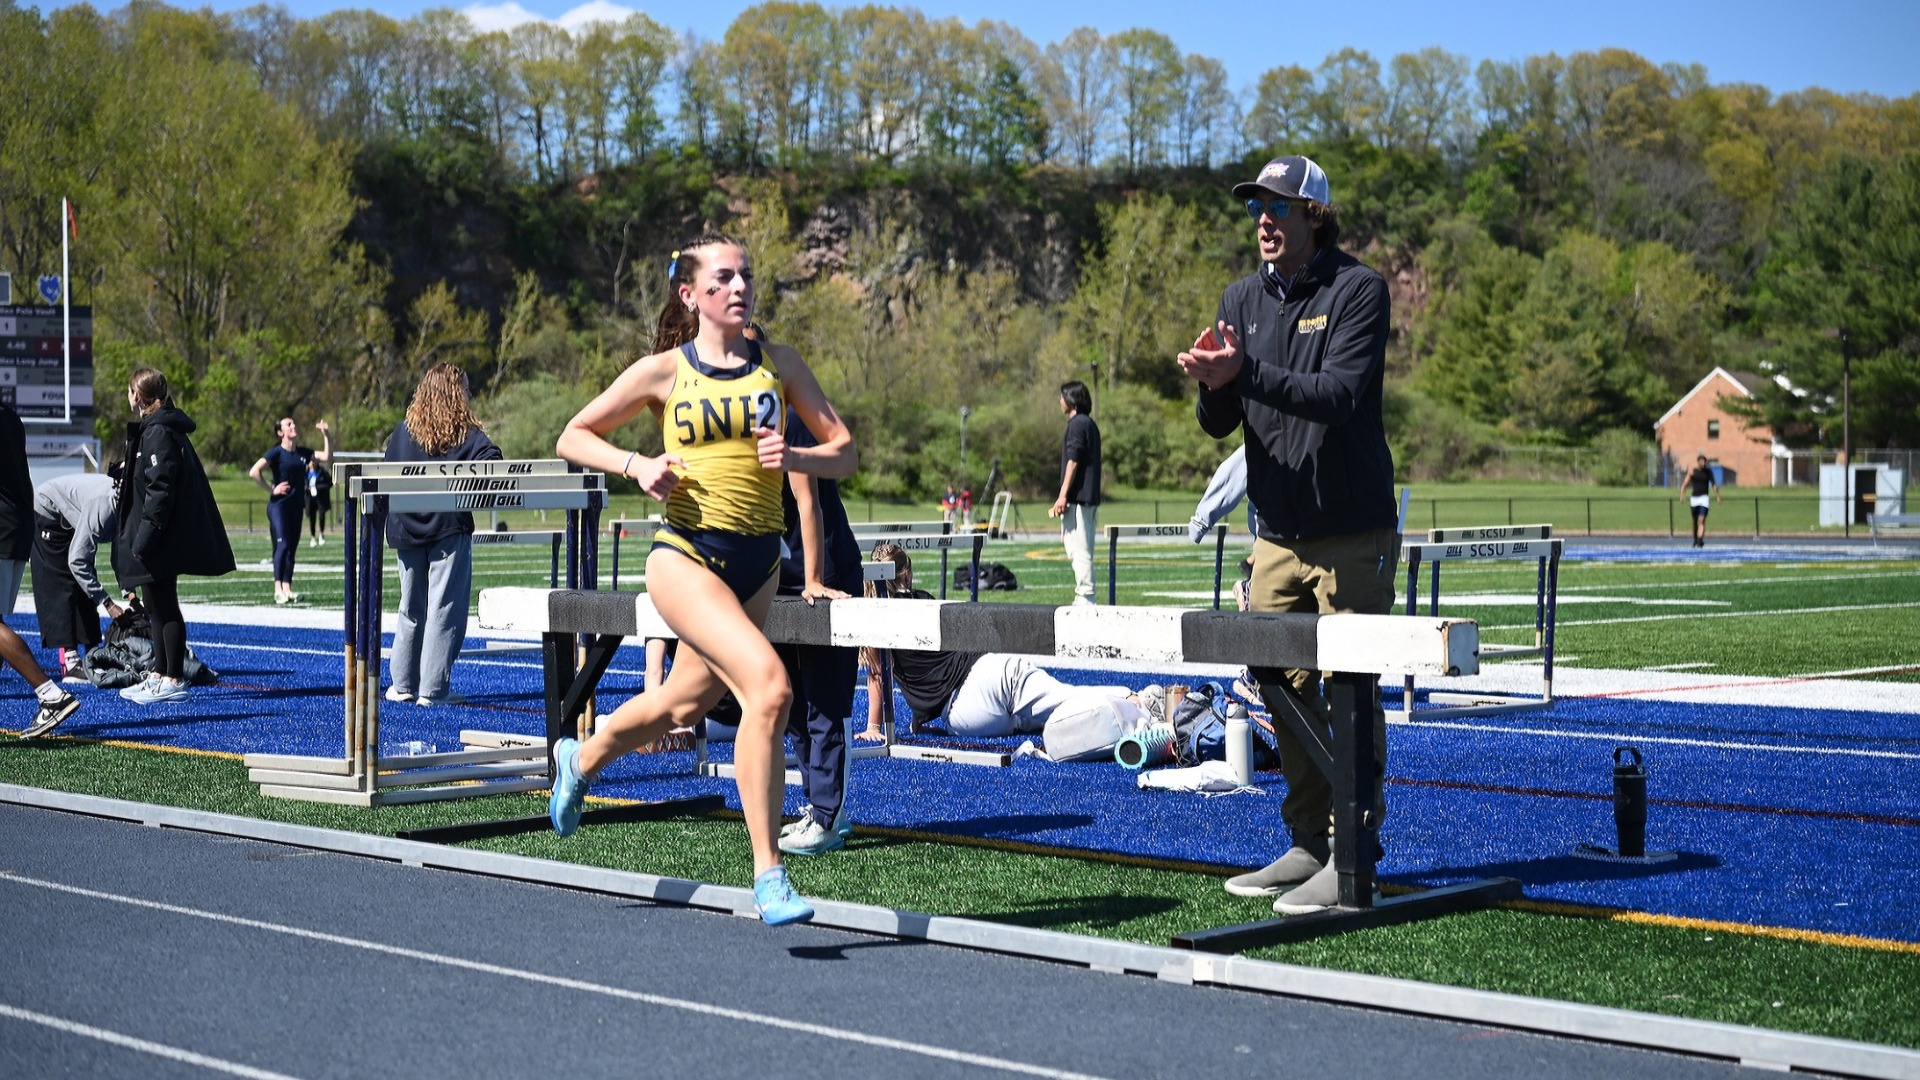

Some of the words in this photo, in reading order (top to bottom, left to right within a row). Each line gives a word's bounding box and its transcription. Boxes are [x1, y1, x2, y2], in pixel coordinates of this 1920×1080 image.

[758, 393, 776, 431] 2
[401, 465, 427, 476] GILL
[508, 463, 533, 474] GILL
[489, 480, 517, 491] GILL
[496, 495, 523, 506] GILL
[1155, 526, 1183, 536] SCSU
[1479, 528, 1507, 539] SCSU
[1446, 545, 1462, 555] GILL
[1470, 543, 1505, 557] SCSU
[1512, 542, 1529, 552] GILL
